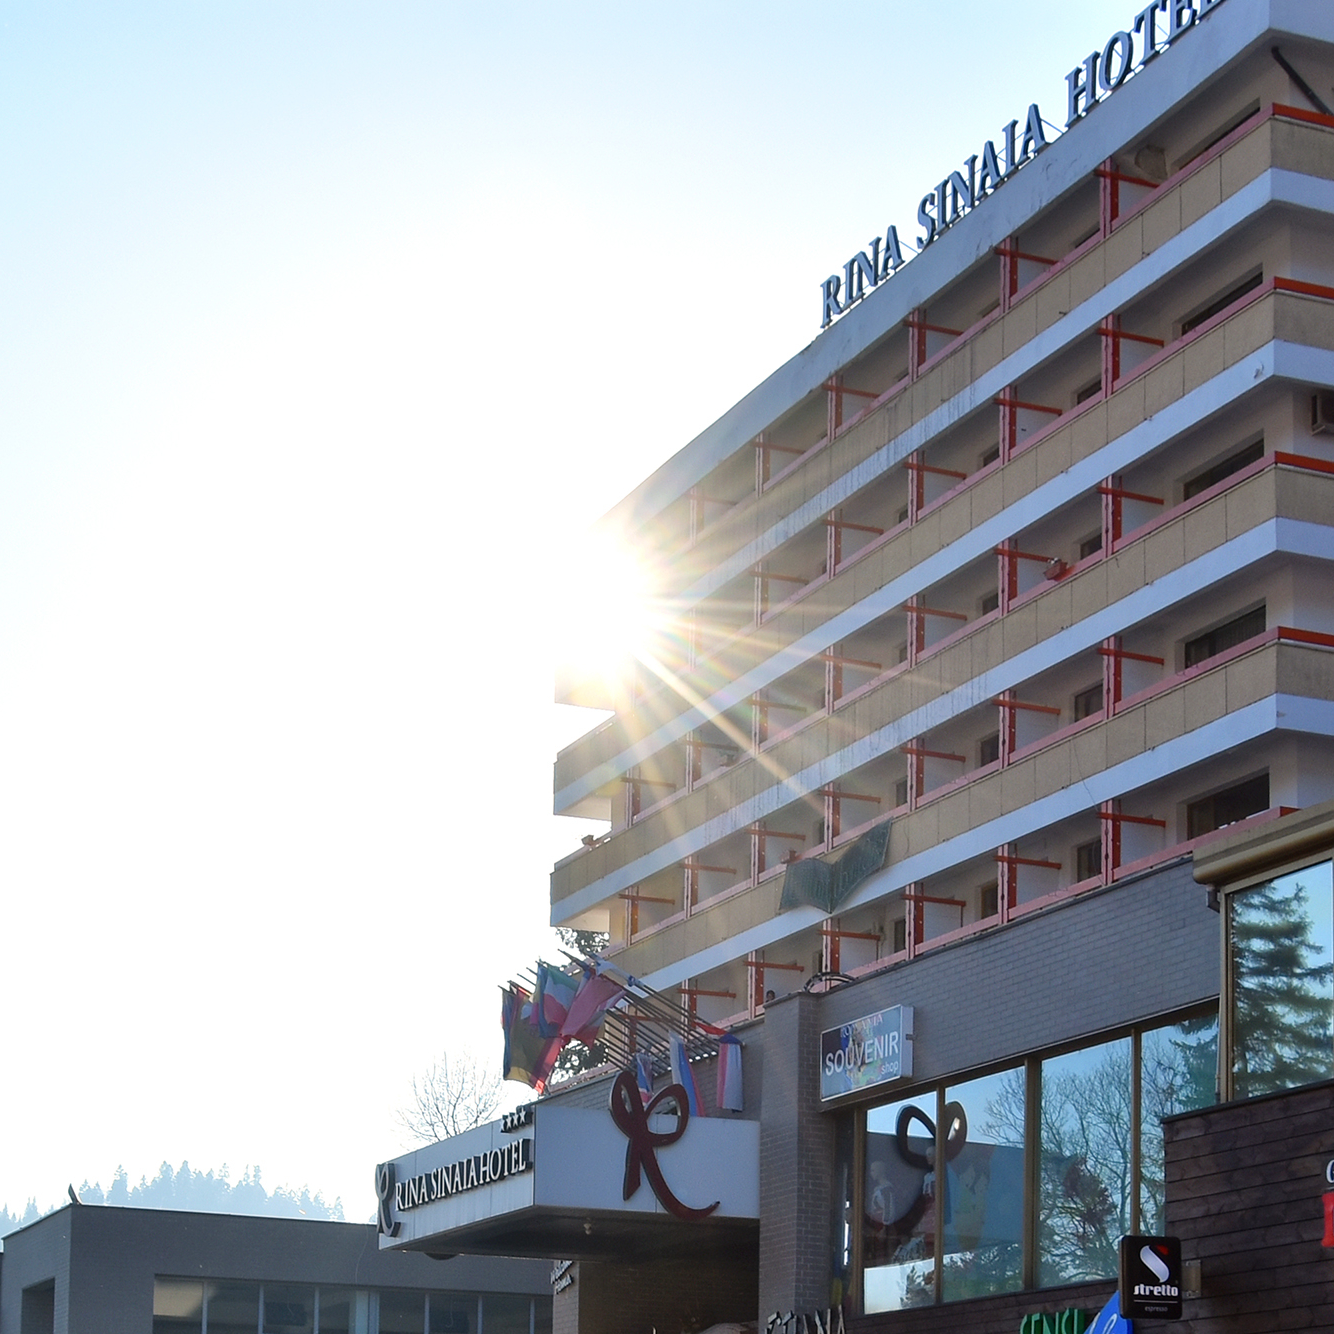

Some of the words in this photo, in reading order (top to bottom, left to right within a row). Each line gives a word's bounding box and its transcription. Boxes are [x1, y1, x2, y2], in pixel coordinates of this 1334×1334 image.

[819, 224, 905, 328] RINA
[917, 104, 1046, 249] SINAIA
[825, 1031, 899, 1076] SOUVENIR
[881, 1061, 899, 1076] shop
[395, 1173, 430, 1212] RINA
[430, 1154, 479, 1201] SINAIA
[478, 1138, 529, 1185] HOTEL
[1133, 1283, 1179, 1298] stretto
[1144, 1305, 1169, 1314] espresso
